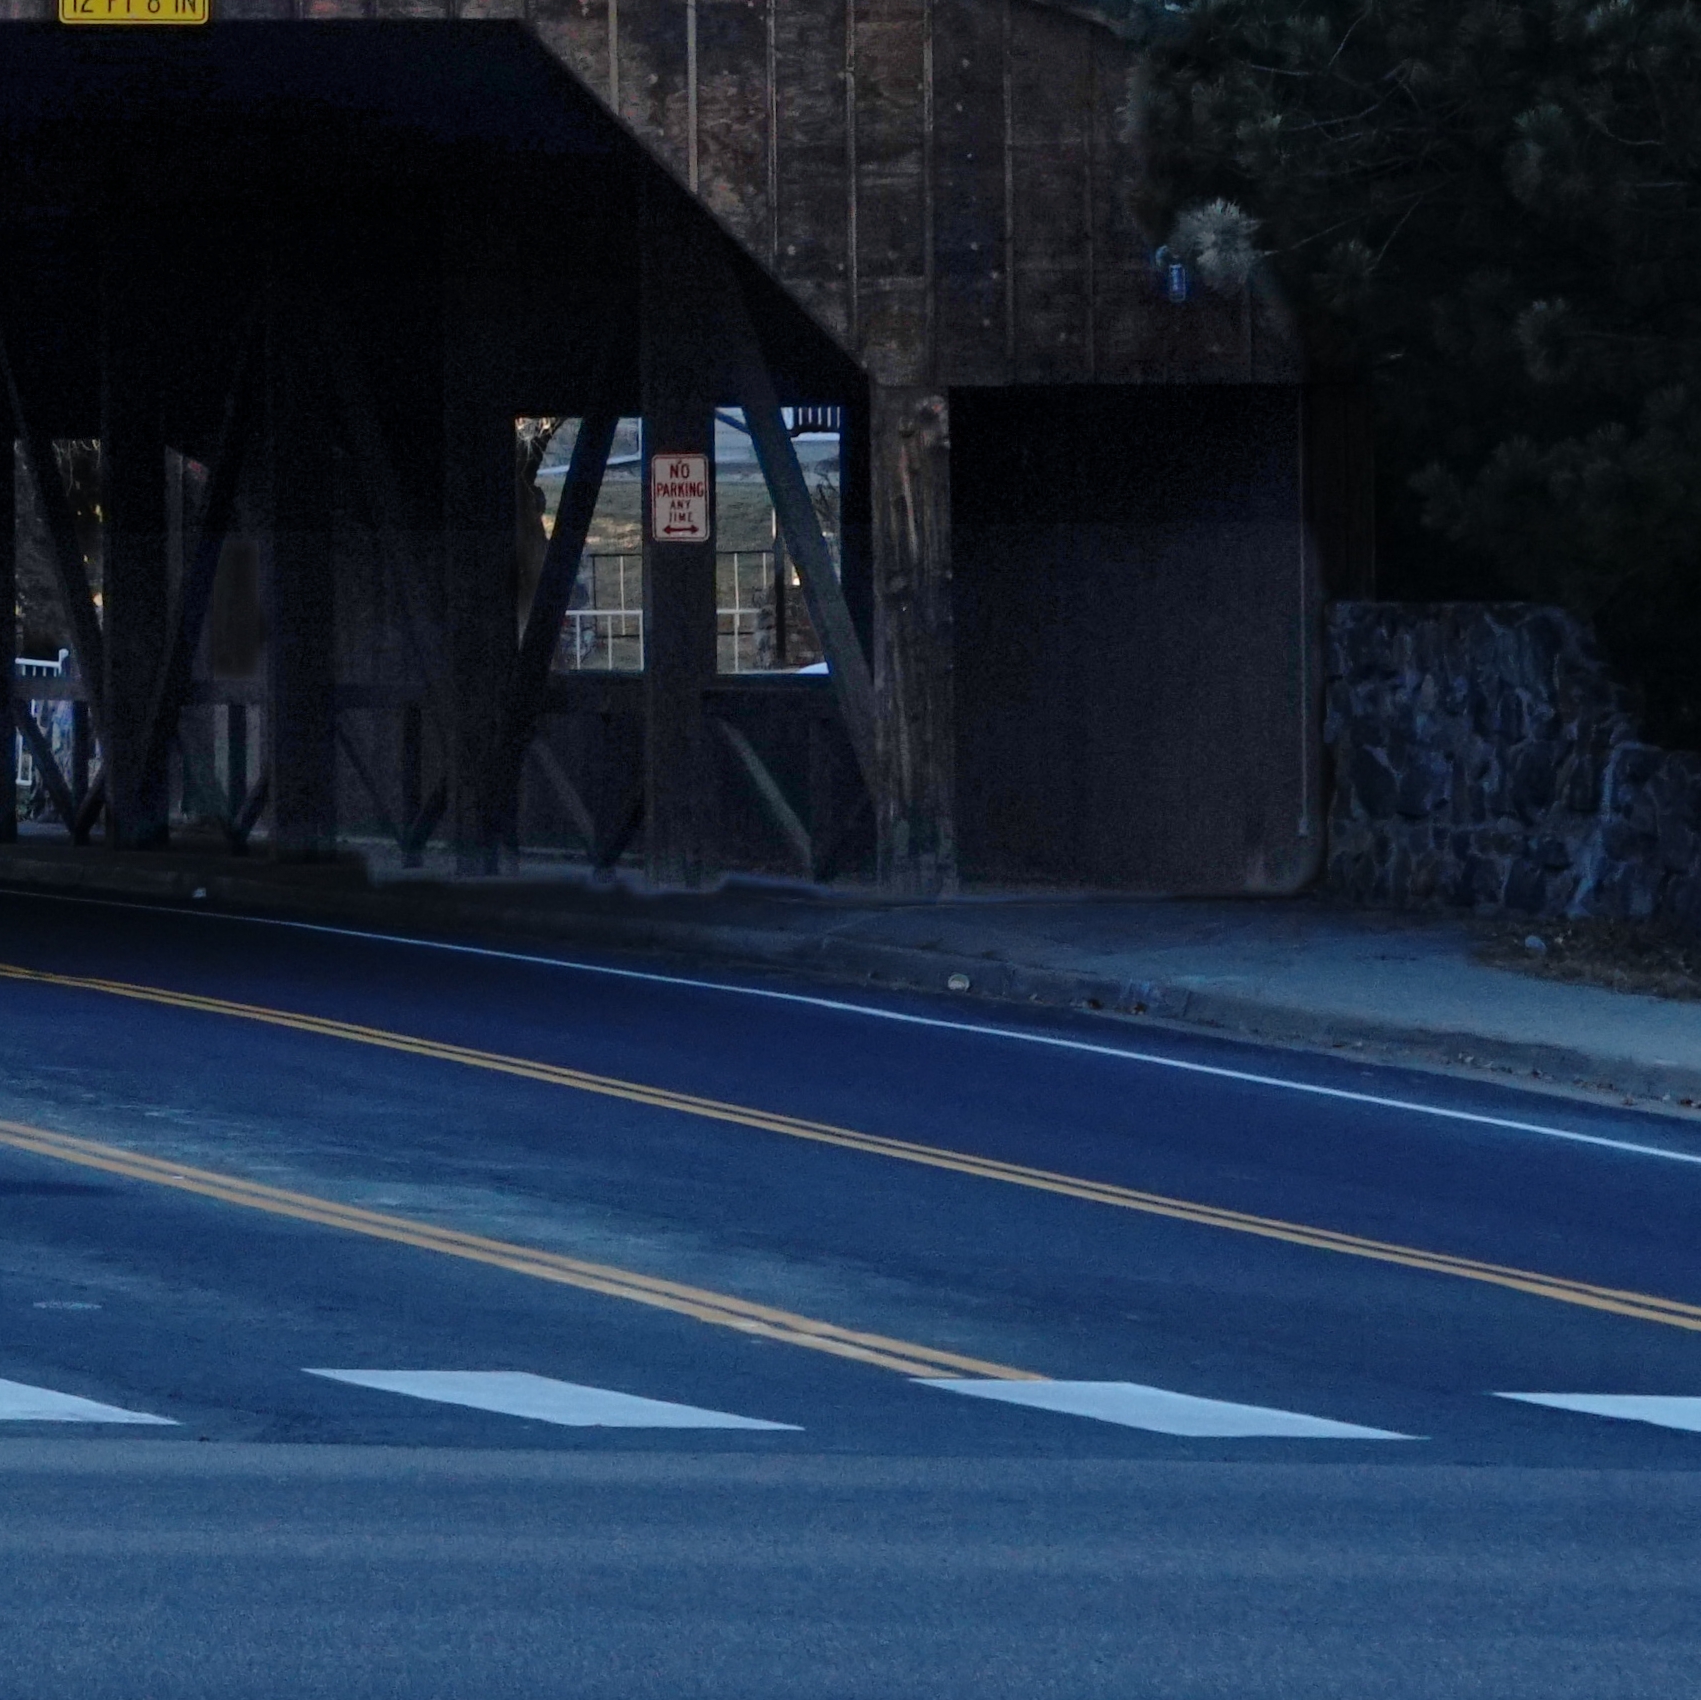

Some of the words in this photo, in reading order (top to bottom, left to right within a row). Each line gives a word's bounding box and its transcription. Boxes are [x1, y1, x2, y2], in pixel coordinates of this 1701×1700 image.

[669, 464, 690, 478] NO
[656, 482, 704, 498] PARKING
[670, 500, 691, 510] ANY
[668, 512, 694, 523] TIME
